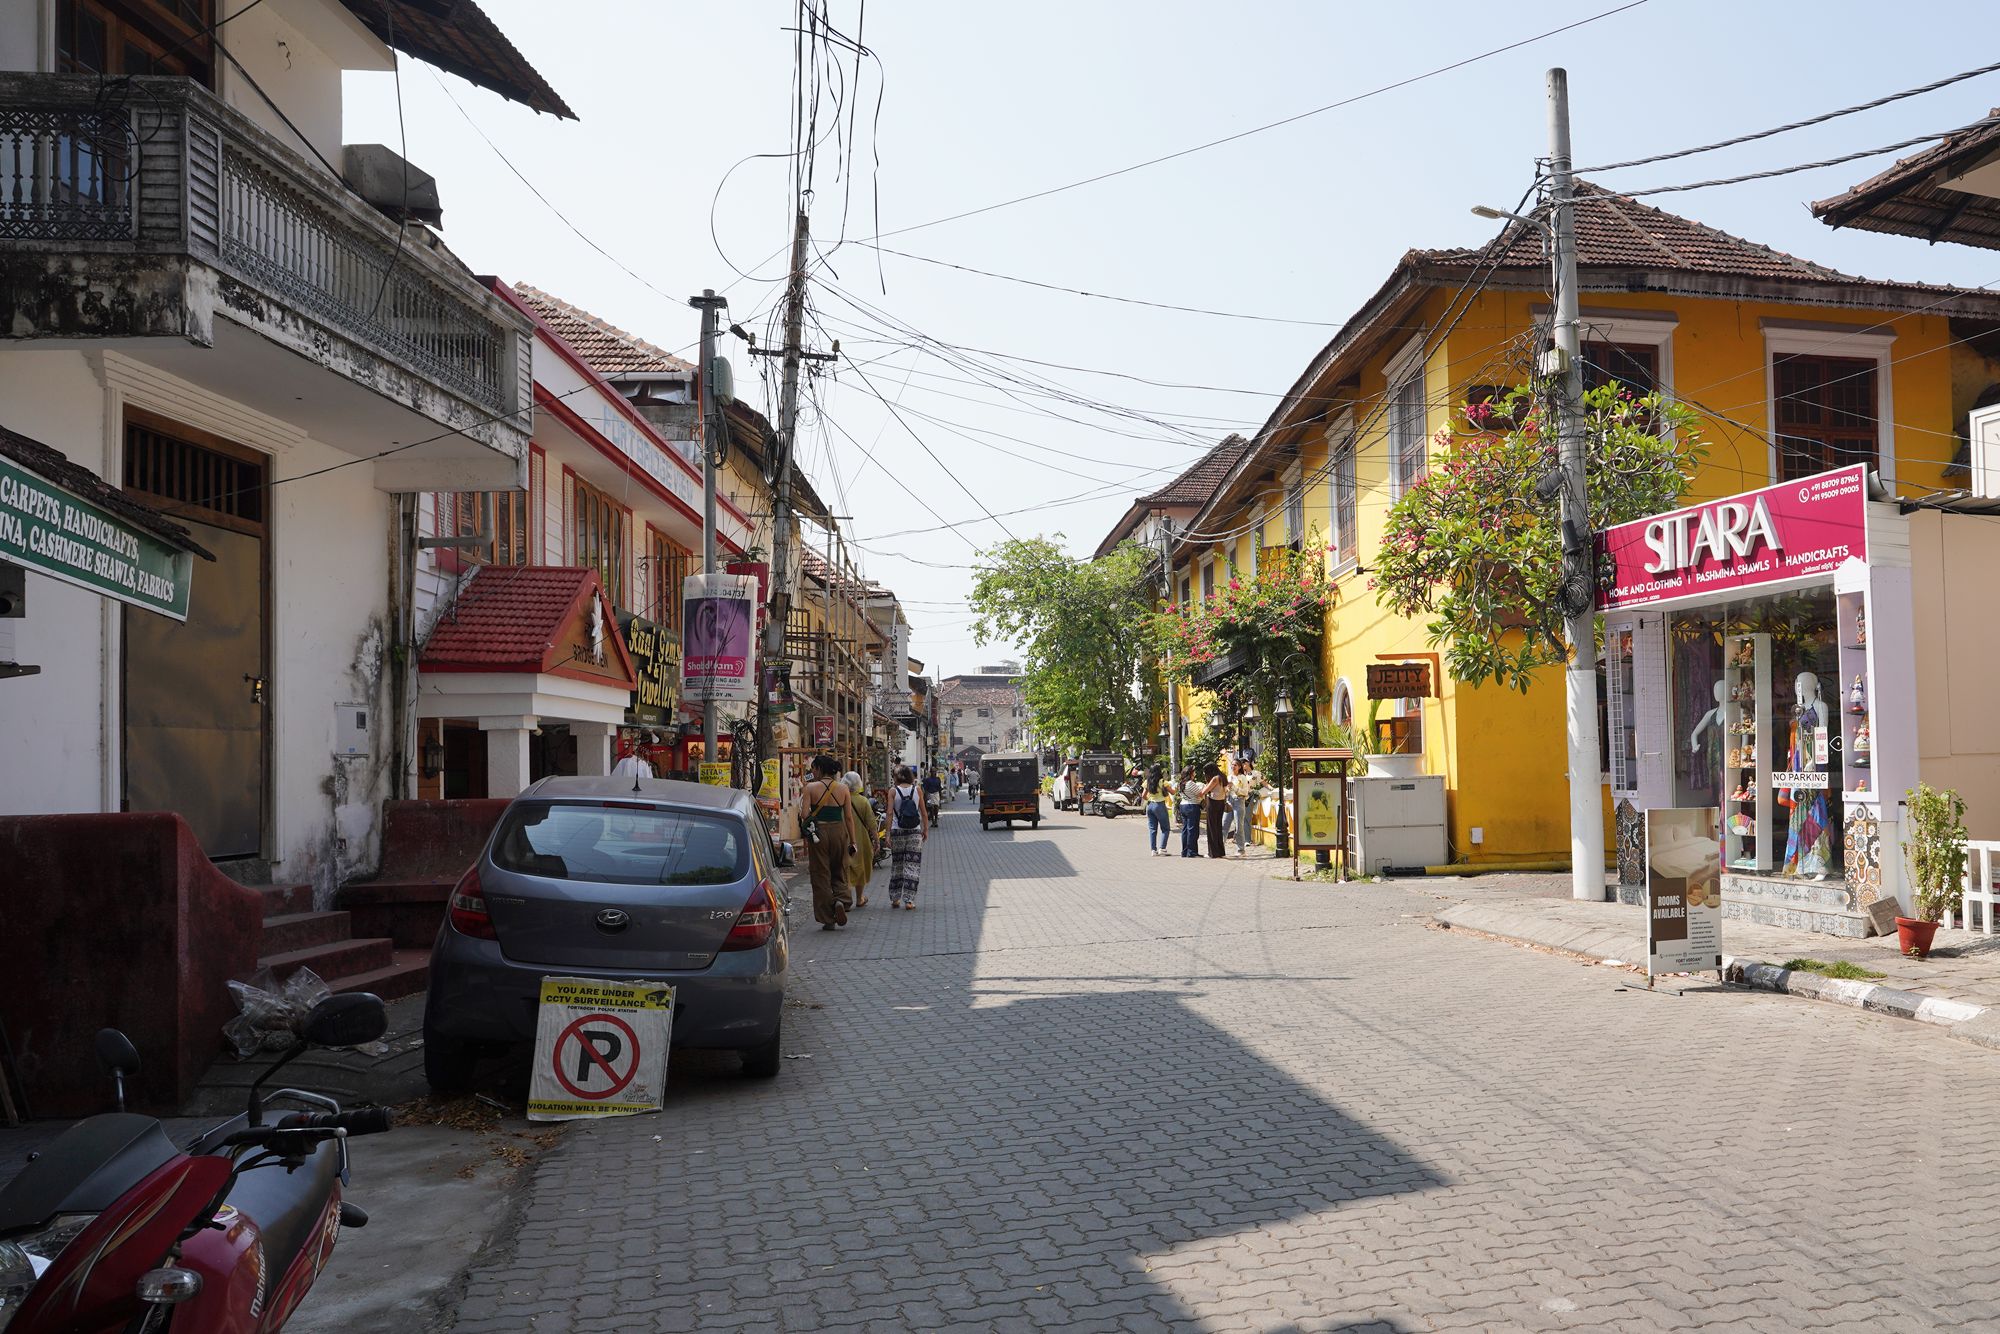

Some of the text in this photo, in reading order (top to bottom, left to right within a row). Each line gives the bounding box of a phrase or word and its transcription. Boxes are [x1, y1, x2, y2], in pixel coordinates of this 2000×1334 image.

[1811, 474, 1859, 492] +91 88709 87965
[1811, 485, 1859, 502] +91 95009 09005
[0, 475, 139, 566] CARPETS, HANDICRAFTS,
[1642, 494, 1784, 576] SITARA
[29, 525, 94, 573] CASHMERE
[94, 552, 136, 594] SHAWLS,
[137, 569, 175, 603] FABRICS
[1609, 587, 1629, 598] HOME
[1630, 582, 1645, 594] AND
[1646, 576, 1683, 592] CLOTHING
[1696, 567, 1736, 584] PASHMINA
[1737, 560, 1770, 576] SHAWLS
[1785, 545, 1849, 567] HANDICRAFTS
[628, 618, 680, 674] Raaj Gems
[1375, 668, 1423, 684] JETTY
[1371, 685, 1427, 694] RESTAURANT
[1773, 773, 1827, 781] NO PARKING
[1657, 895, 1680, 906] ROOMS
[710, 910, 733, 920] i20
[1653, 908, 1686, 919] AVAILABLE
[557, 986, 635, 998] YOU ARE UNDER
[546, 995, 646, 1008] CCTV SURVEILLANCE
[528, 1103, 573, 1112] VIOLATION
[575, 1104, 596, 1112] WILL
[598, 1104, 610, 1112] BE
